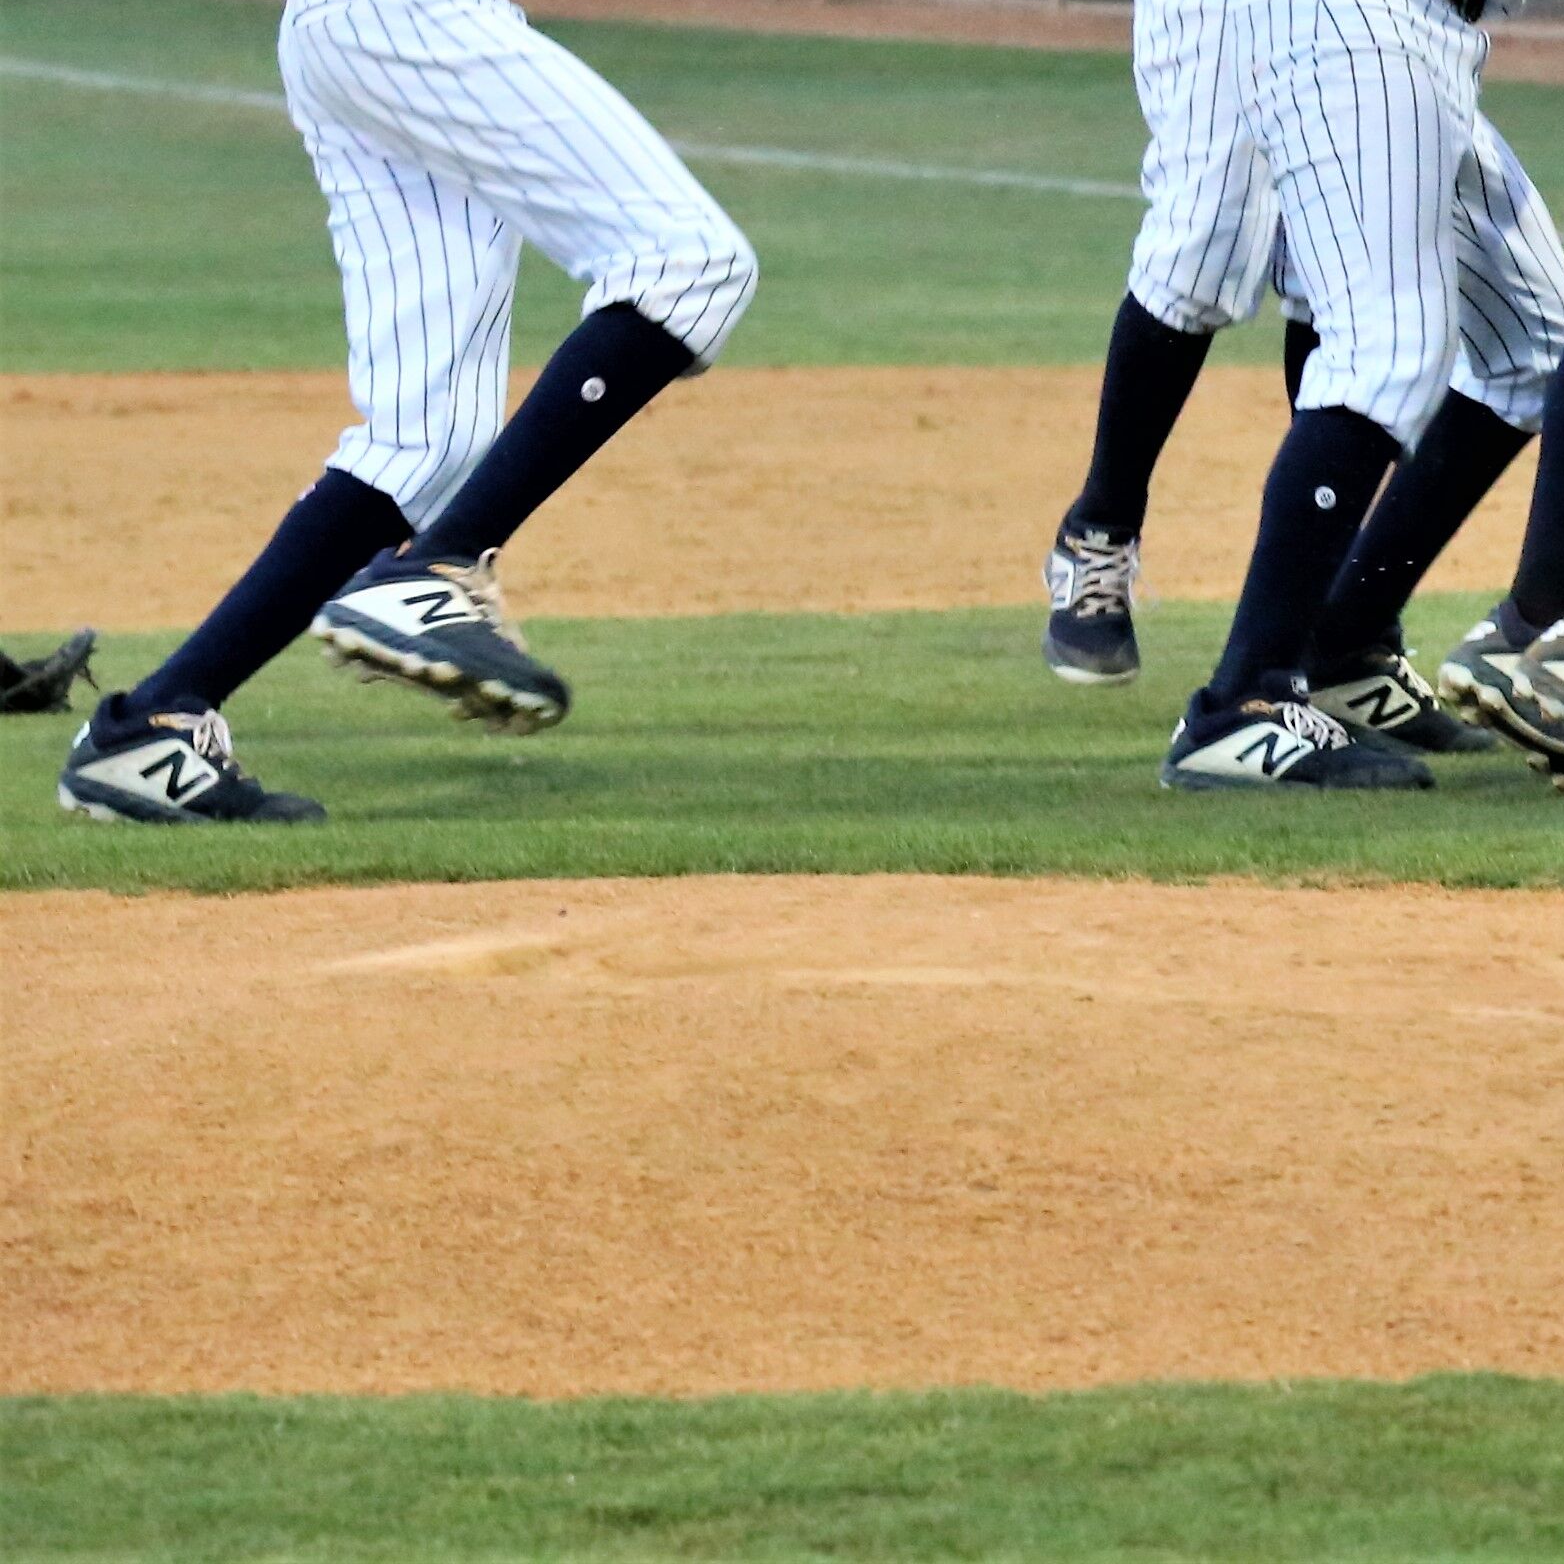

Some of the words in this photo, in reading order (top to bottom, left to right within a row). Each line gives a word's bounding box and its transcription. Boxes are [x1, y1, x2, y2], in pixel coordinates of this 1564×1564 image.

[1347, 684, 1413, 727] N
[139, 749, 211, 800] N
[1238, 732, 1304, 776] N
